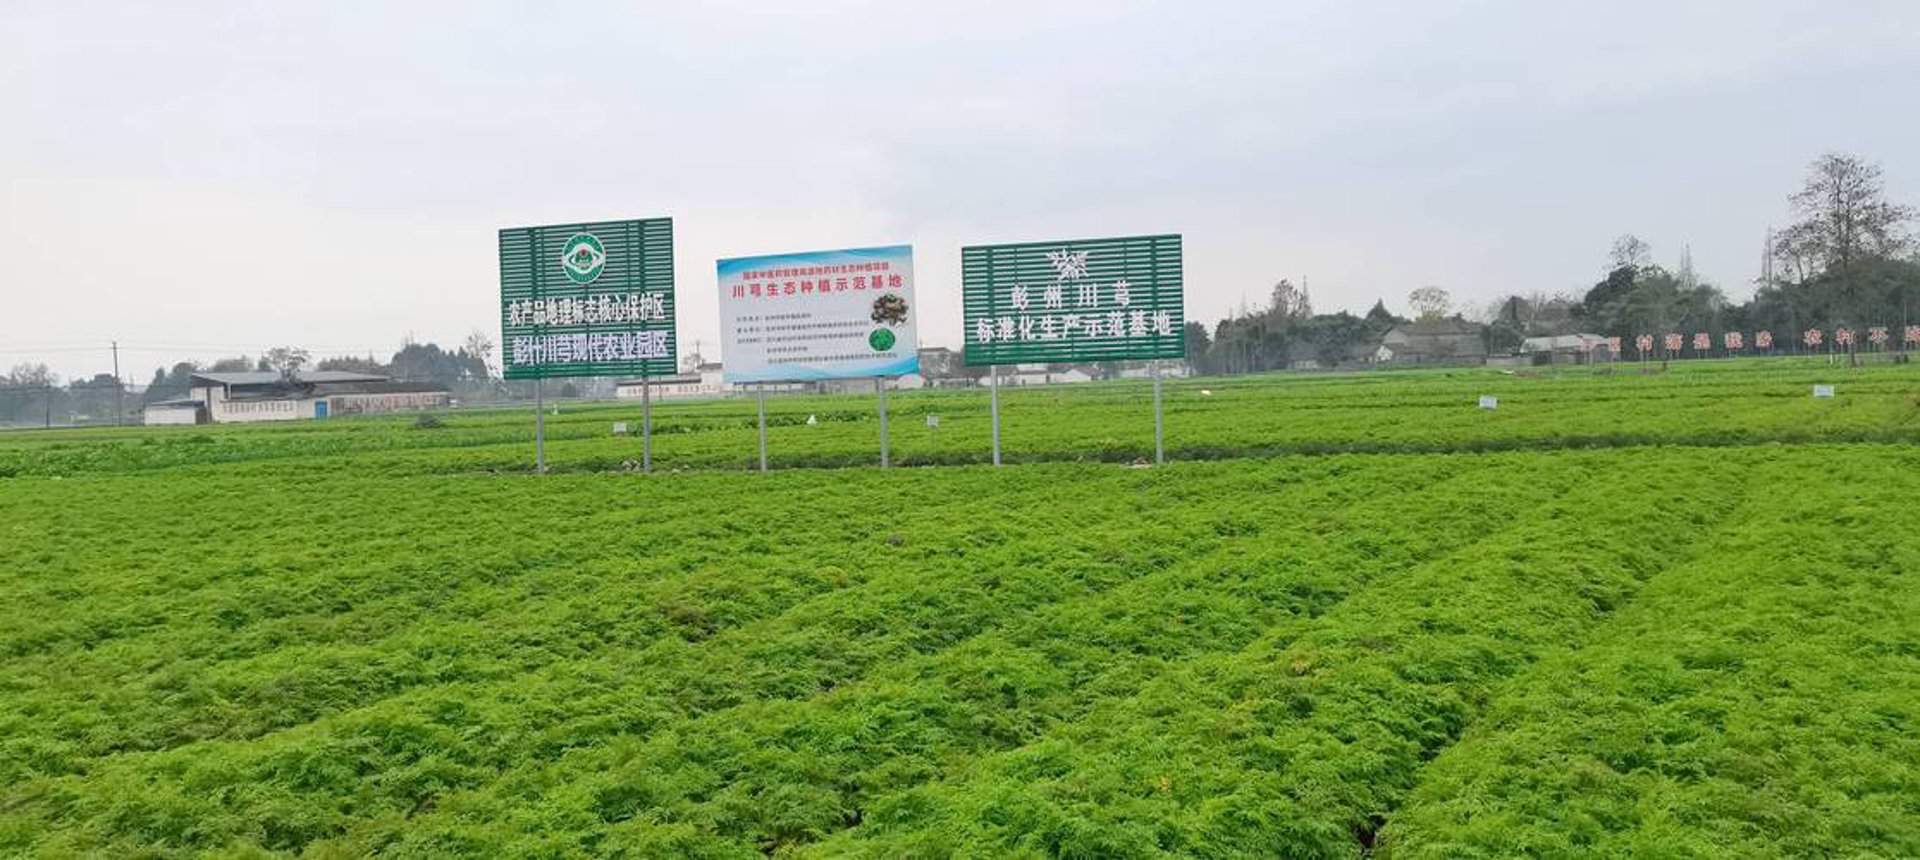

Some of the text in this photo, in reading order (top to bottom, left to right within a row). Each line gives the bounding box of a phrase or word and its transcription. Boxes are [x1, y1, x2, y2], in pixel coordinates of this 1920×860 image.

[732, 274, 903, 300] 川芎生态种植示范基地
[1011, 279, 1131, 310] 彭州川芎
[509, 292, 665, 327] 农产品地理标志核心保护区
[976, 310, 1173, 344] 标准化生产示范基地
[512, 331, 668, 366] 彭州川芎现代农业园区
